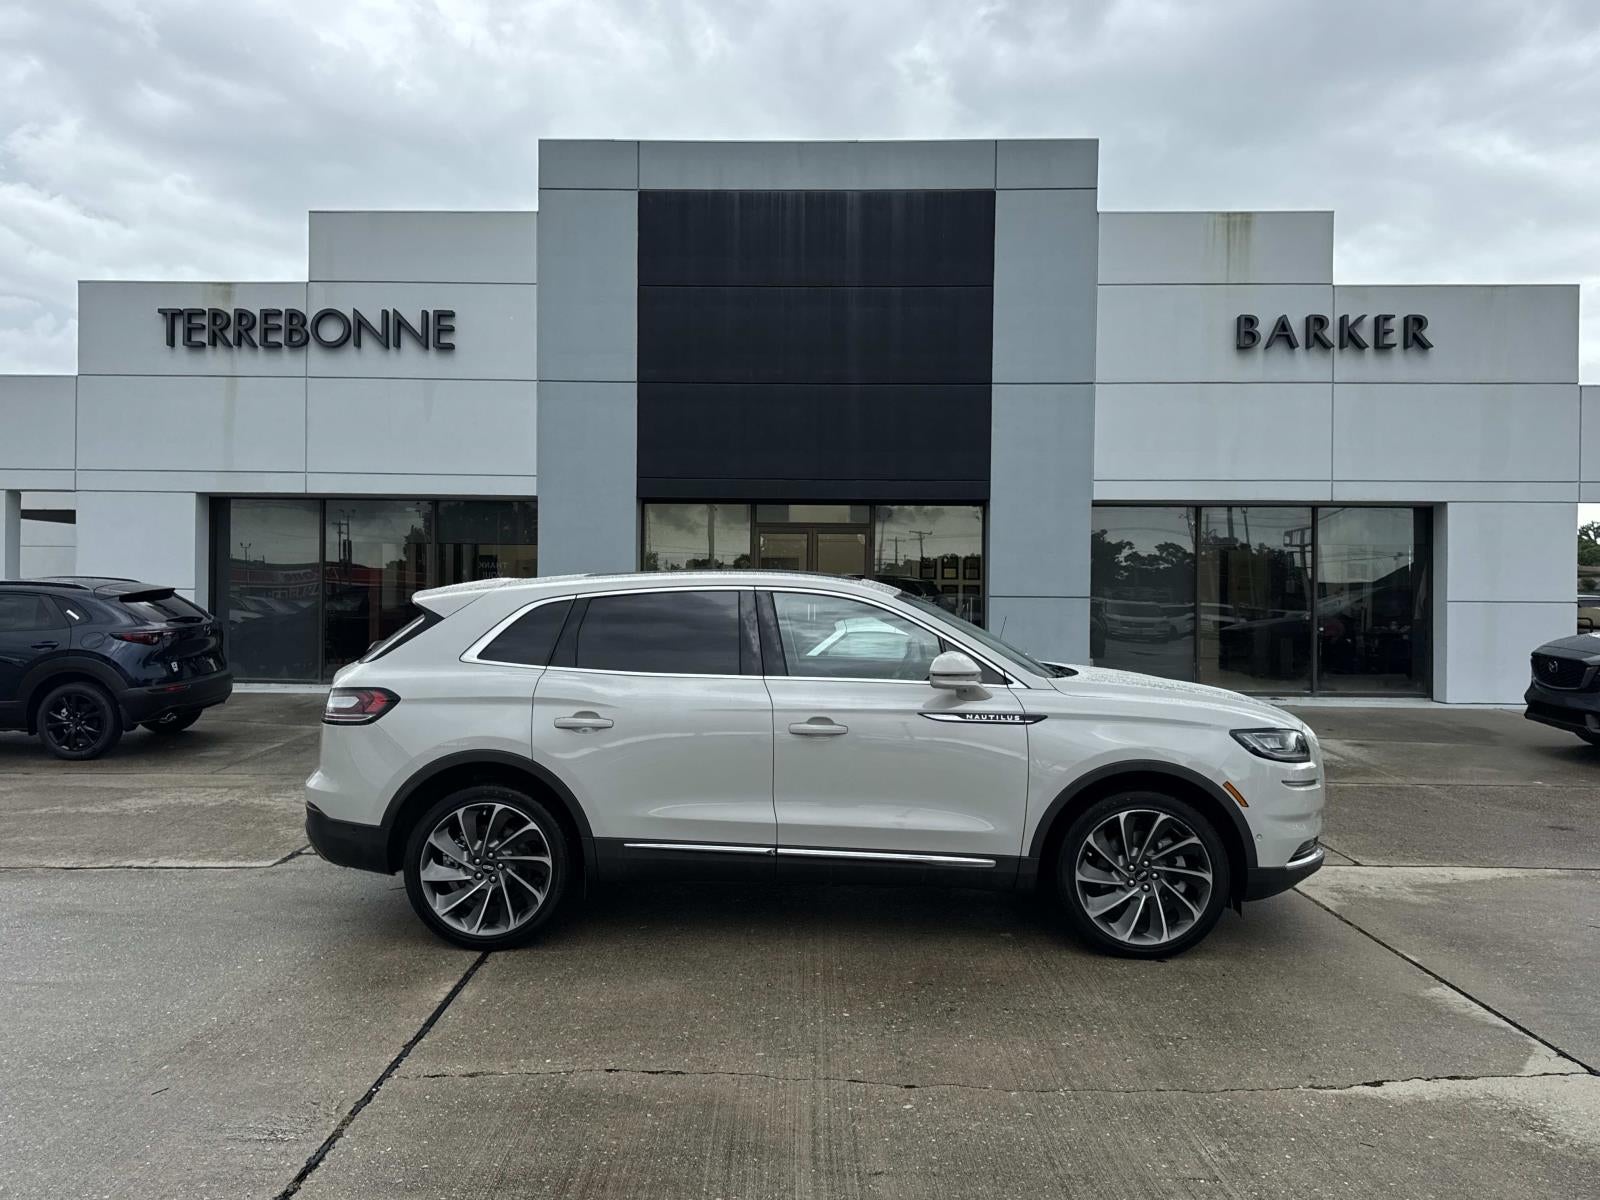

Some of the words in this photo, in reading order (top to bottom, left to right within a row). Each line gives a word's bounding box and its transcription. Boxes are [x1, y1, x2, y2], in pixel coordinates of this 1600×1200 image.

[157, 307, 456, 349] TERREBONNE
[1236, 314, 1434, 350] BARKER
[965, 713, 1020, 721] NAUTILUS
